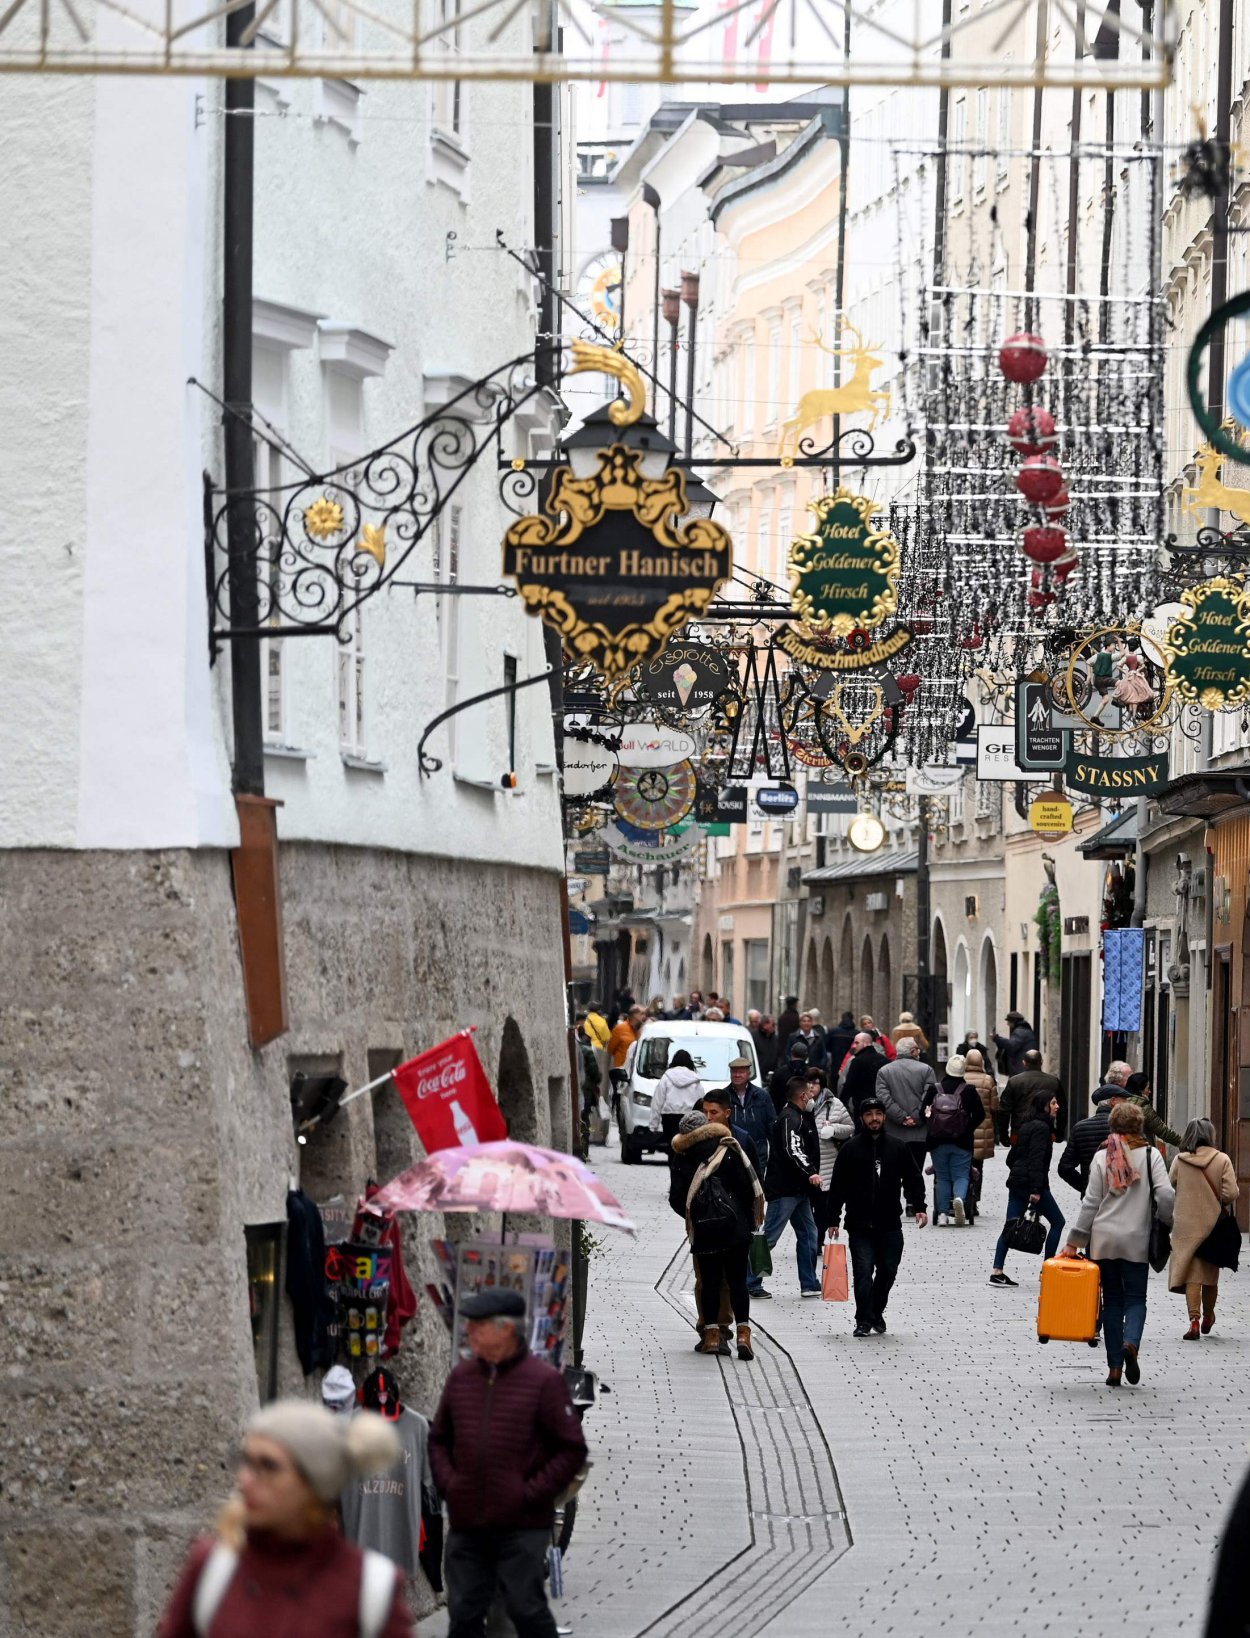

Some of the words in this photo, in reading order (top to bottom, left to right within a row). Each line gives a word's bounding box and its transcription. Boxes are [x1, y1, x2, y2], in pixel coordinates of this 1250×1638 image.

[821, 523, 865, 540] Hotel
[515, 549, 611, 576] Furtner
[618, 550, 719, 577] Hanisch
[812, 552, 876, 571] Goldener
[820, 583, 868, 599] Hirsch
[1198, 611, 1236, 626] Hotel
[776, 628, 911, 669] Kupferschmiedhaus
[1188, 638, 1243, 655] Goldener
[1192, 667, 1236, 681] Hirsch
[657, 690, 676, 699] seit
[694, 691, 714, 699] 1958
[1075, 764, 1160, 788] STASSNY
[759, 792, 796, 804] Berlitz
[617, 843, 689, 861] Aschauer
